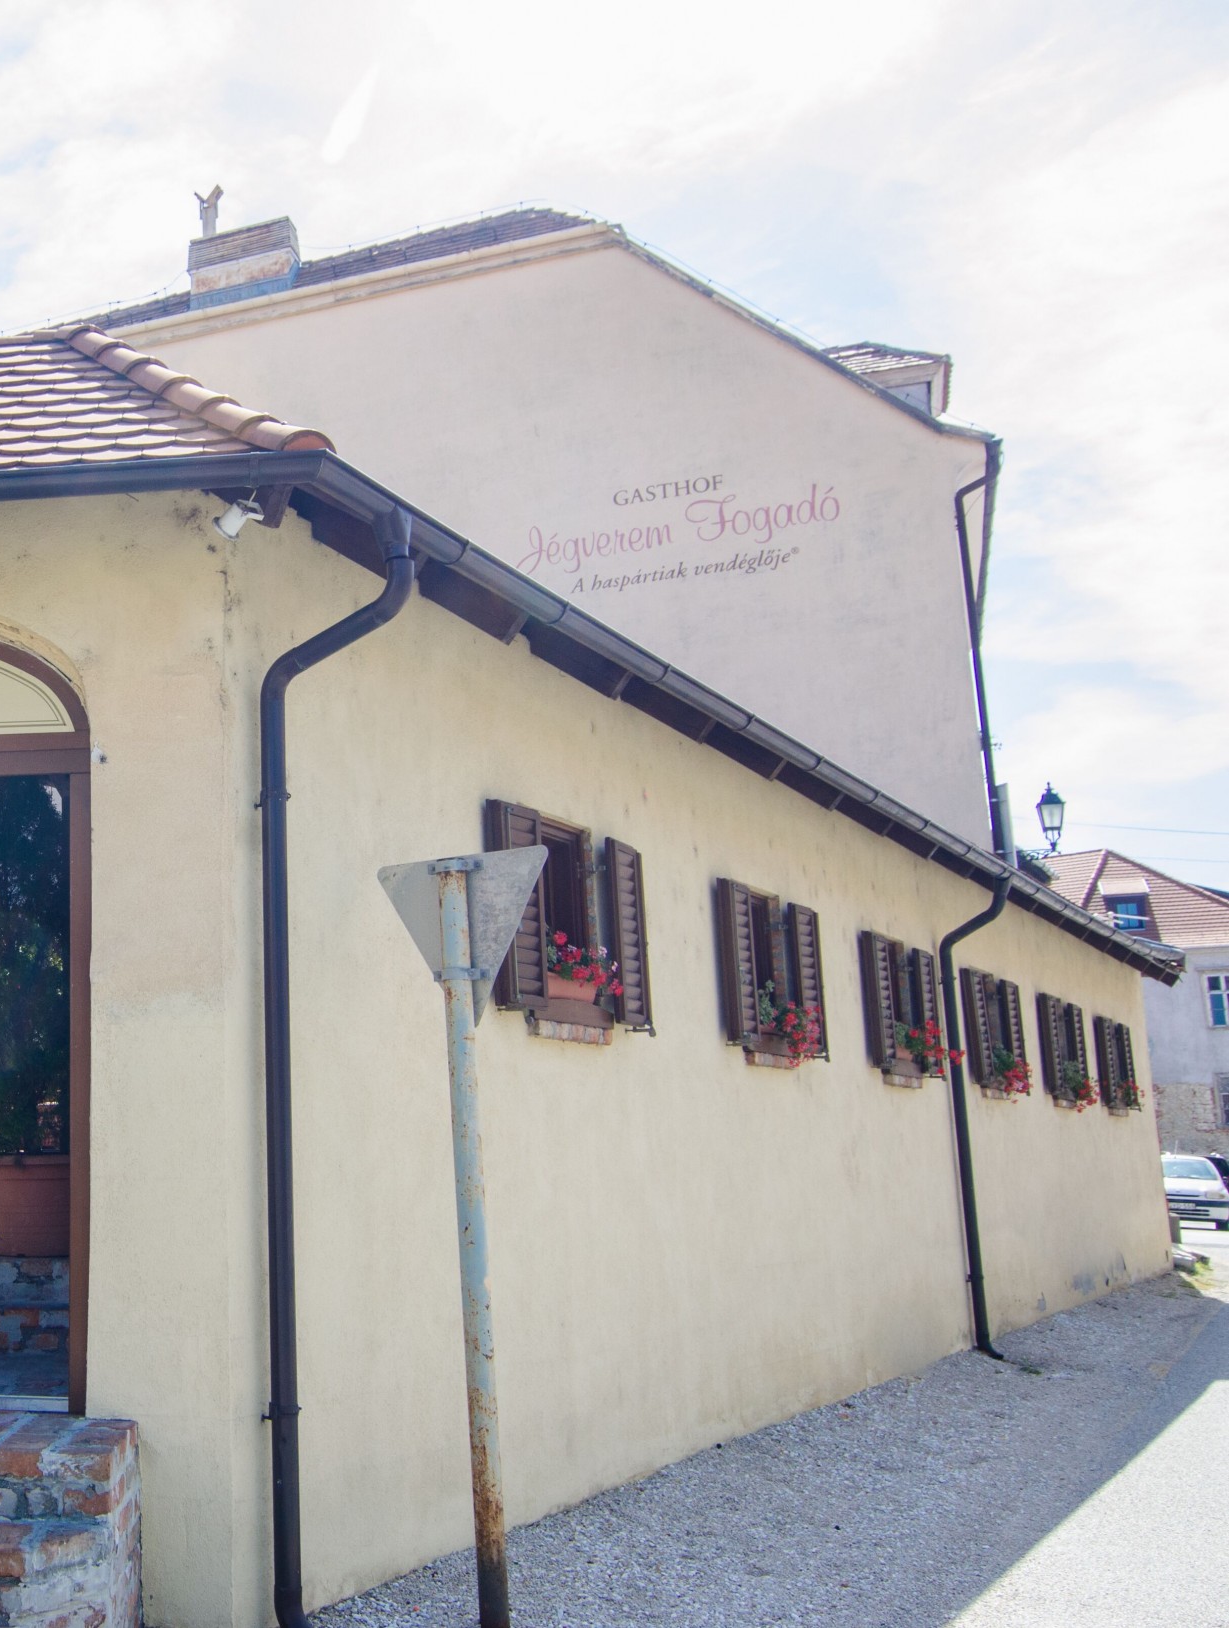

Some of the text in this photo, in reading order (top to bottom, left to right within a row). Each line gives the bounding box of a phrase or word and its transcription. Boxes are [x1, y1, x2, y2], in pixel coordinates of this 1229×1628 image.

[613, 475, 723, 506] GASTHOF
[516, 483, 840, 575] Jégverem Fogadó
[571, 577, 584, 594] A
[591, 561, 688, 592] haspártiak
